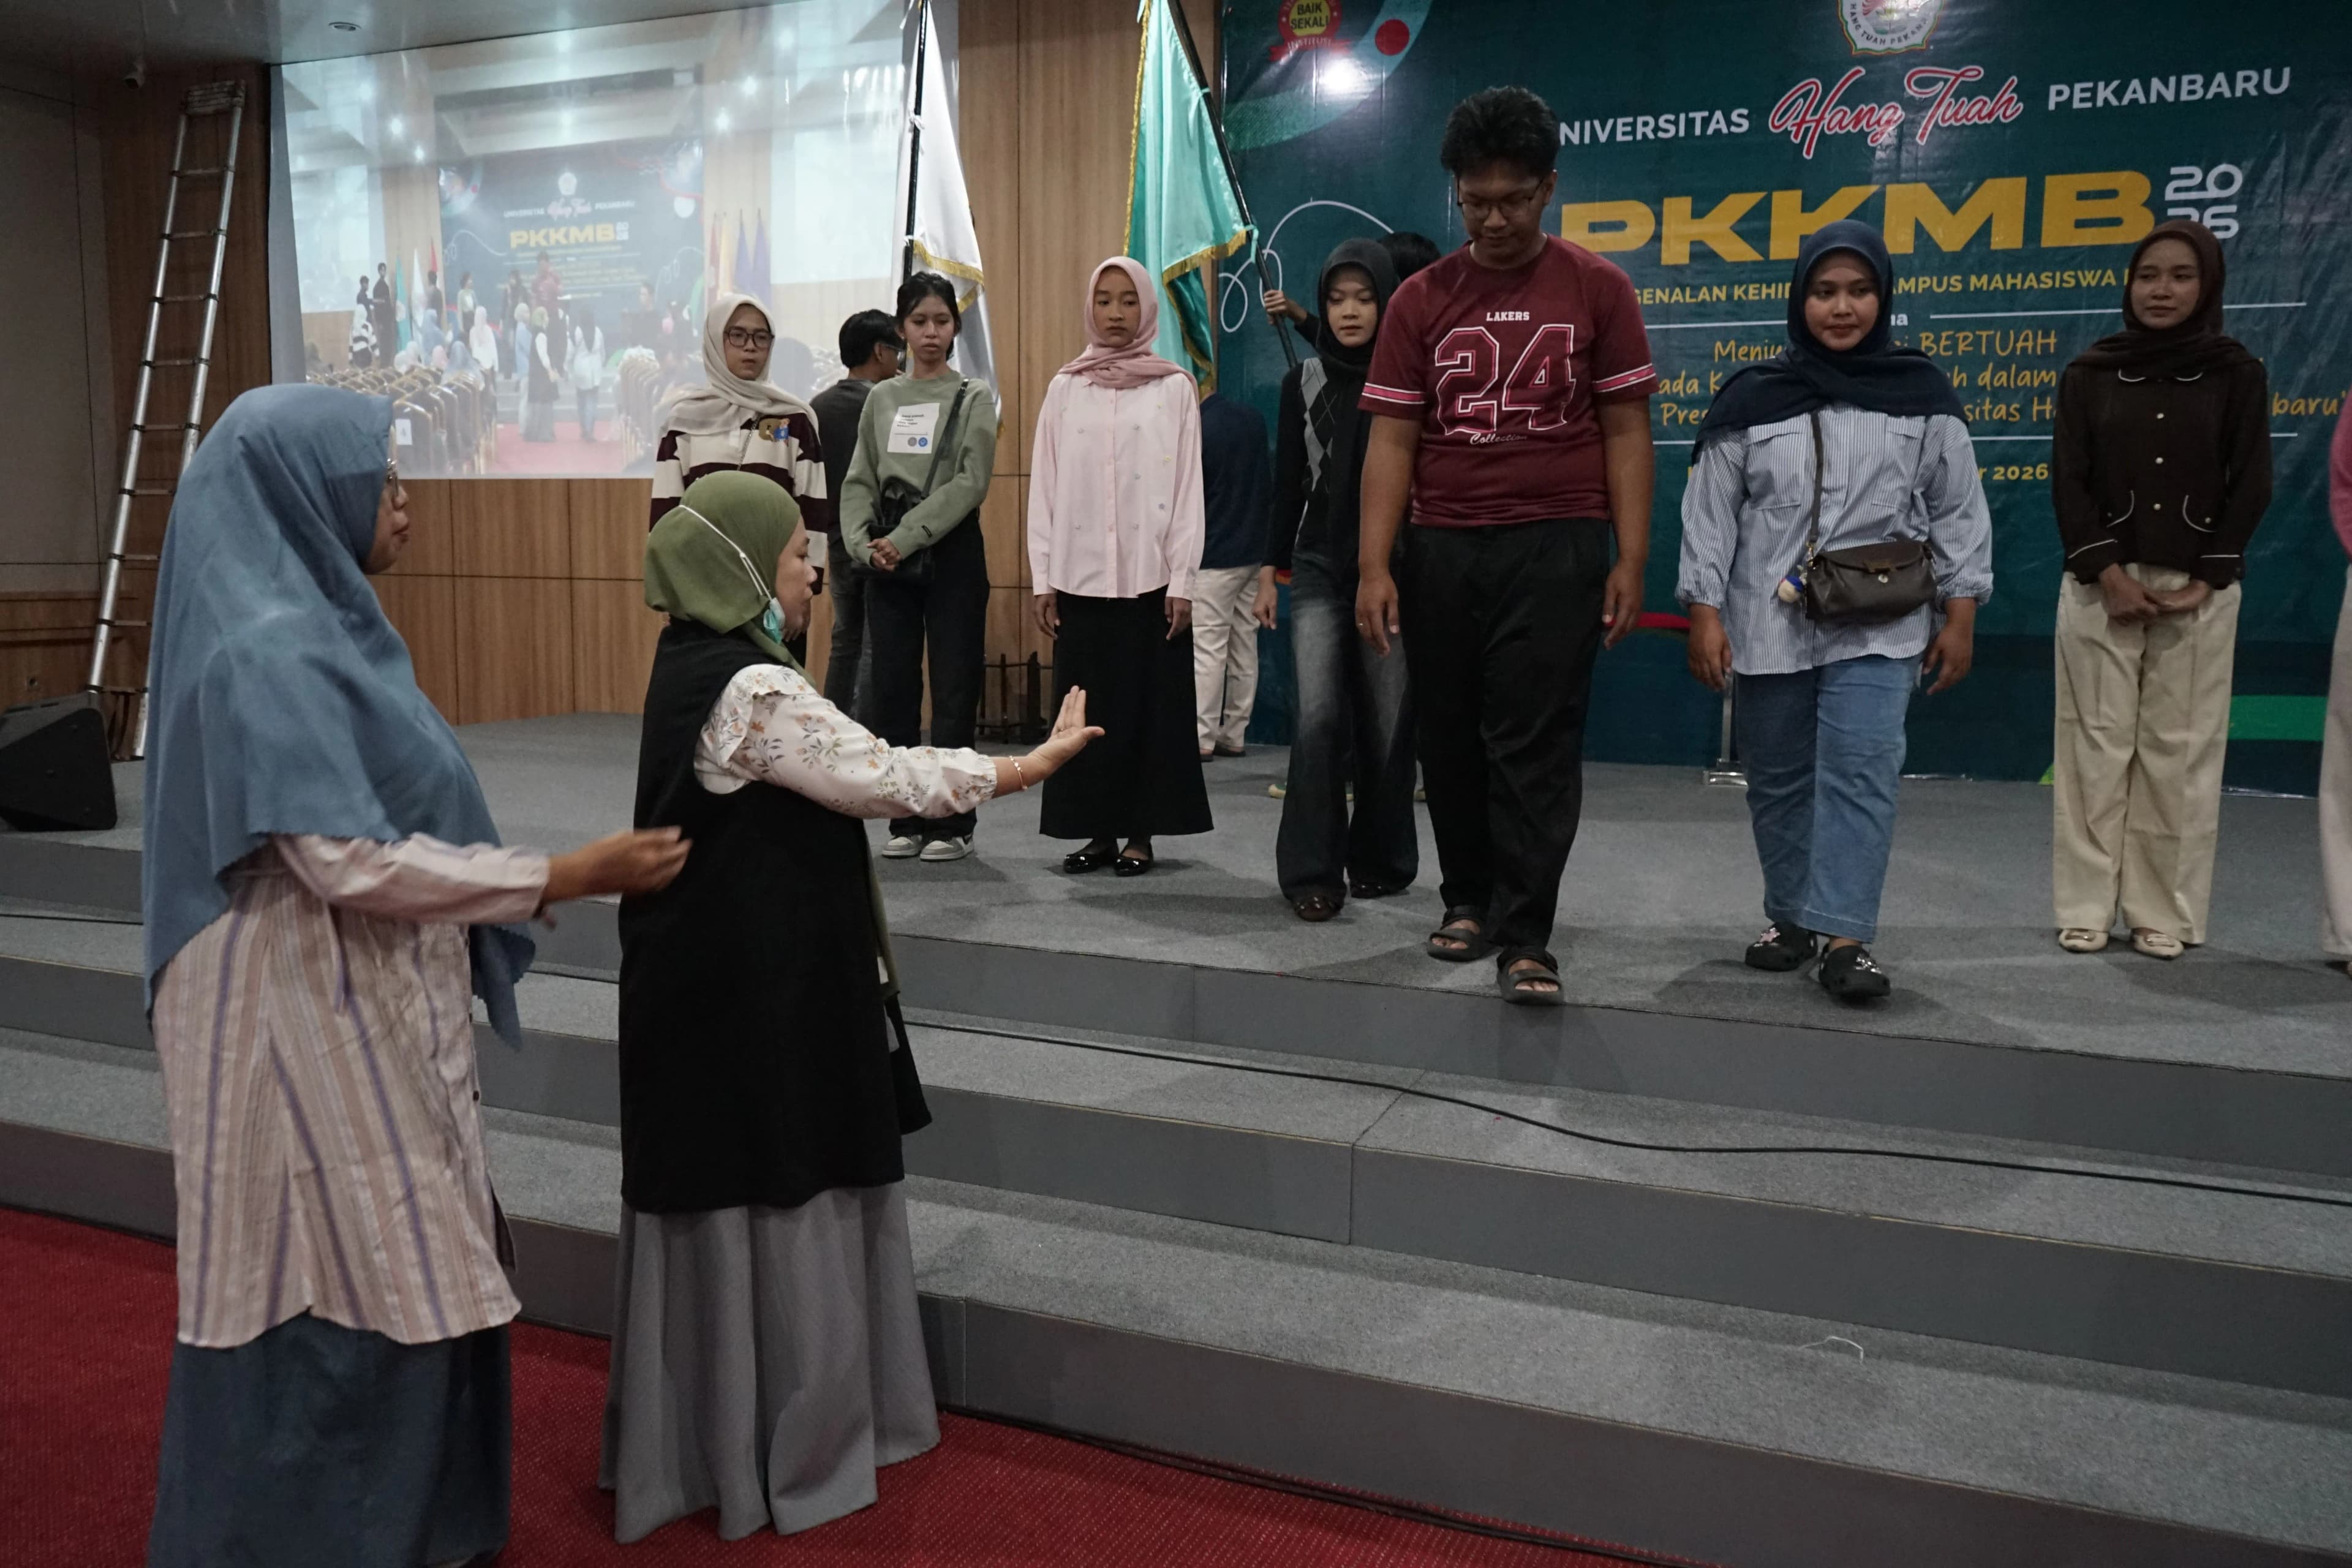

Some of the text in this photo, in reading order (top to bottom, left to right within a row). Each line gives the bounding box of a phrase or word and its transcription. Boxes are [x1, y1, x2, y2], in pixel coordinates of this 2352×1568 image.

[1291, 15, 1329, 29] SEKALI
[1297, 2, 1322, 15] BAIK
[1850, 4, 1861, 31] HANG
[1861, 31, 1886, 45] TUAH
[1560, 66, 2291, 159] NIVERSITAS Hang Tuah PEKANBARU
[2165, 164, 2242, 201] 20
[1561, 170, 2155, 266] PKKMB
[510, 222, 615, 249] PKKMB
[1893, 275, 1962, 295] MPUS
[1970, 268, 2117, 292] MAHASISWA
[1486, 311, 1530, 322] LAKERS
[1919, 329, 2057, 357] BERTUAH
[1435, 323, 1577, 435] 24
[1658, 370, 1700, 397] ada
[1977, 363, 2057, 391] dalam
[1964, 397, 2021, 422] sitas
[1470, 433, 1528, 445] Collection
[1992, 463, 2048, 480] 2026
